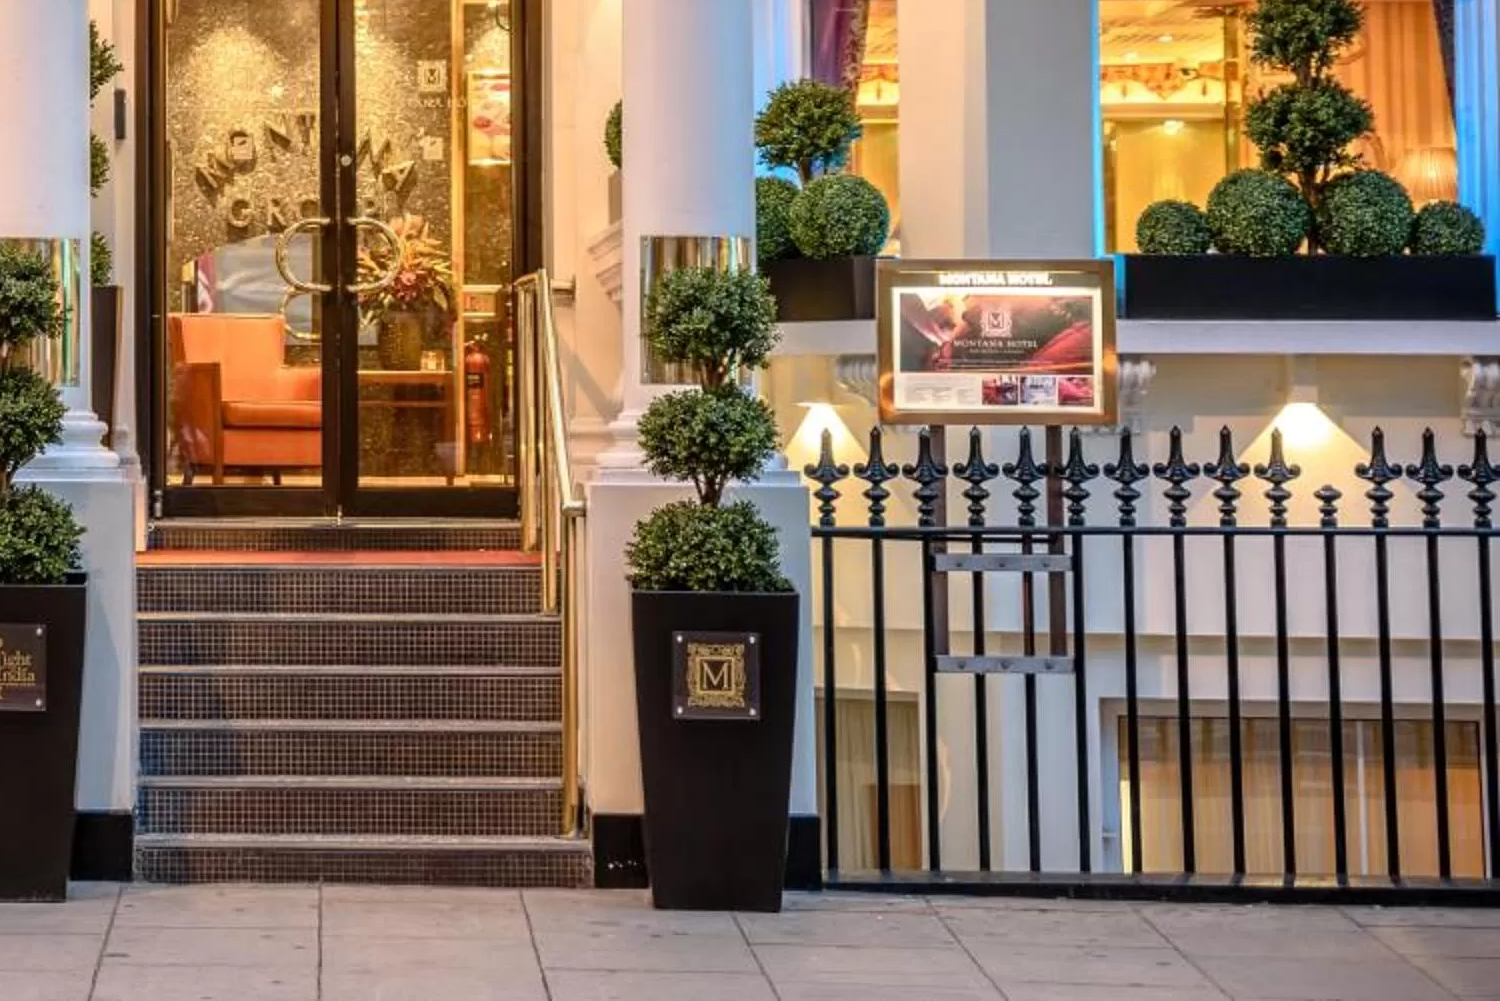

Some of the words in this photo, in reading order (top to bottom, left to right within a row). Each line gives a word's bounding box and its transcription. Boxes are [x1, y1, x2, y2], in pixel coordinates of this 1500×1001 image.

[194, 112, 415, 196] MONTNA
[228, 198, 378, 229] GROP
[702, 661, 729, 690] M
